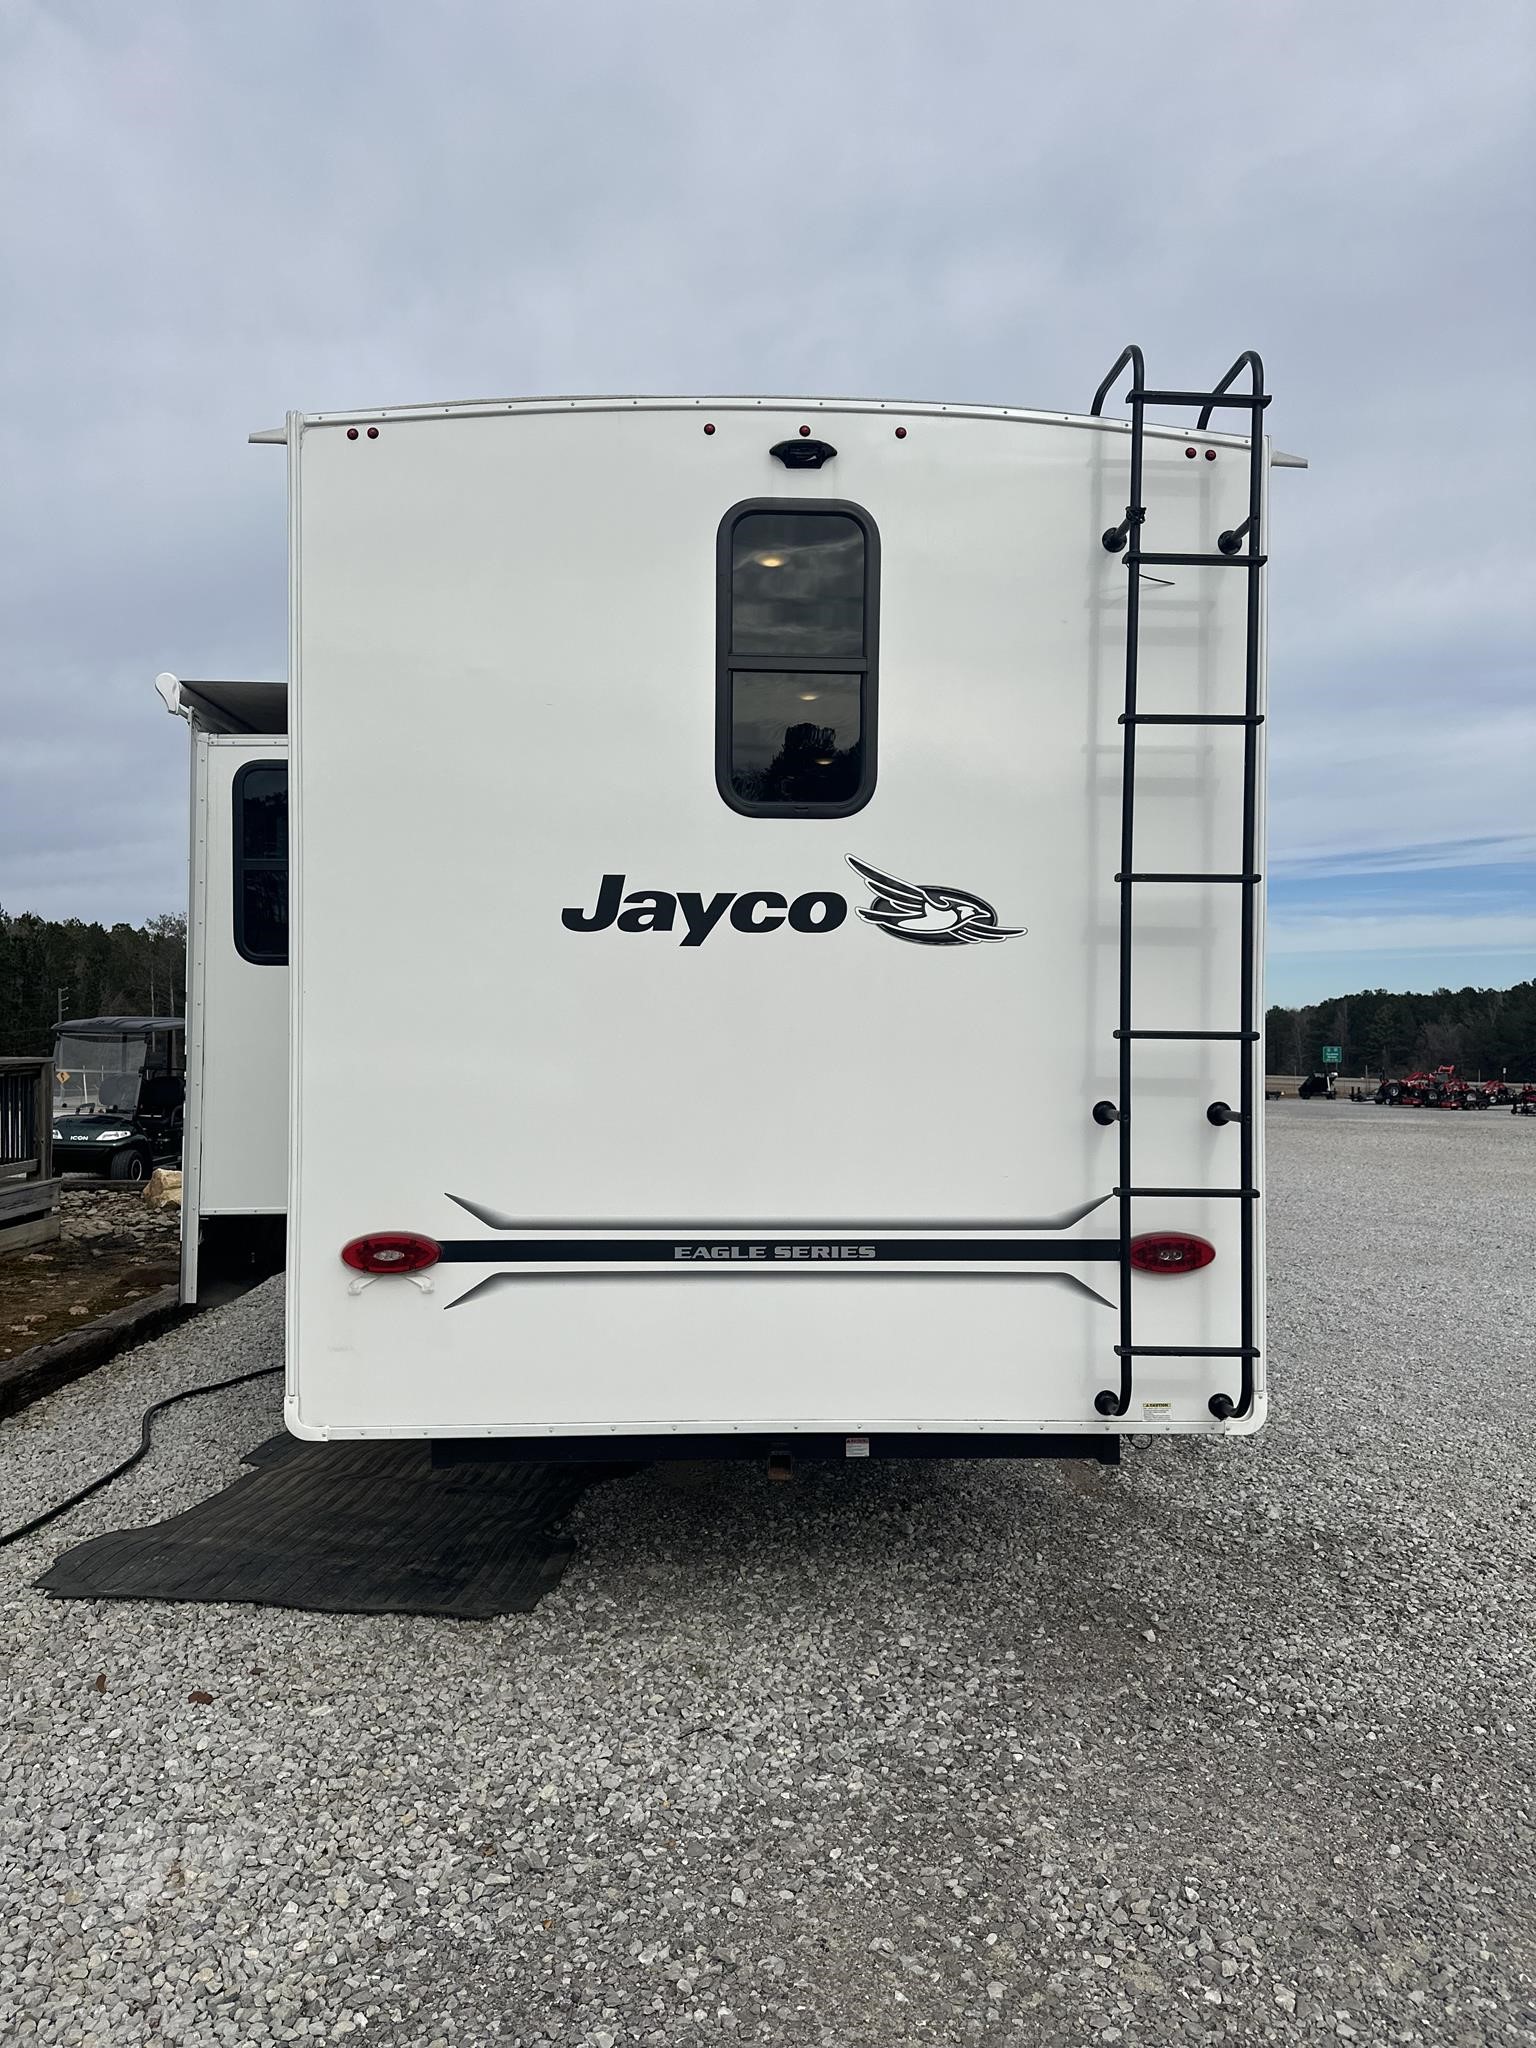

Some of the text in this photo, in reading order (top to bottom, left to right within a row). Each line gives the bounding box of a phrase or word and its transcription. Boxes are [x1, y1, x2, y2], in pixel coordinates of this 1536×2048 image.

[561, 874, 848, 947] Jayco
[674, 1246, 876, 1260] EAGLE SERIES
